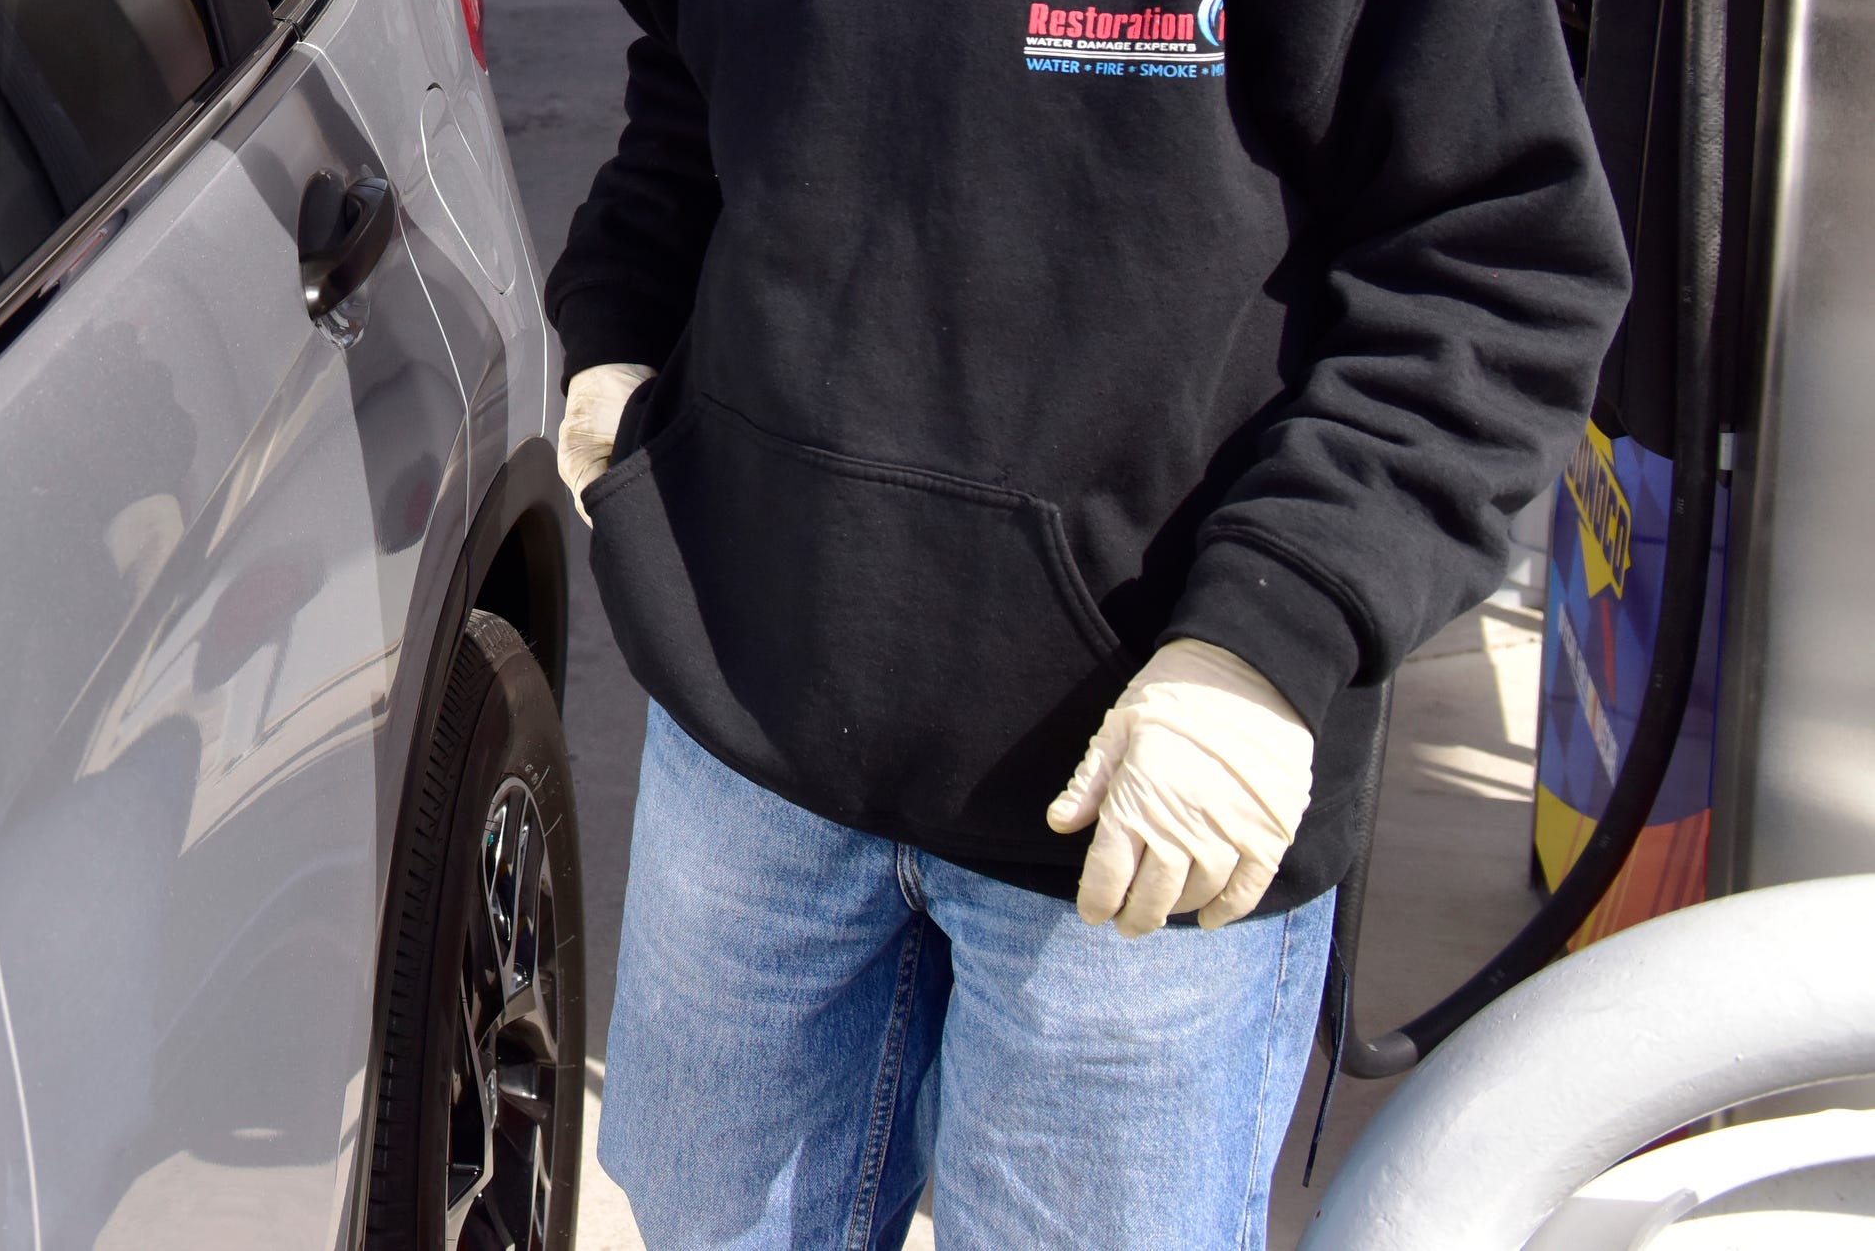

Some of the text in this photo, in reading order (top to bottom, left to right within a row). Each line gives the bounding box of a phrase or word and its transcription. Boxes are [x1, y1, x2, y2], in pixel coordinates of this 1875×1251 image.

[1028, 3, 1194, 41] Restoration
[1026, 36, 1197, 53] WATER DAMAGE EXPERTS
[1026, 57, 1080, 75] WATER
[1095, 61, 1124, 76] FIRE
[1139, 63, 1197, 78] SMOKE
